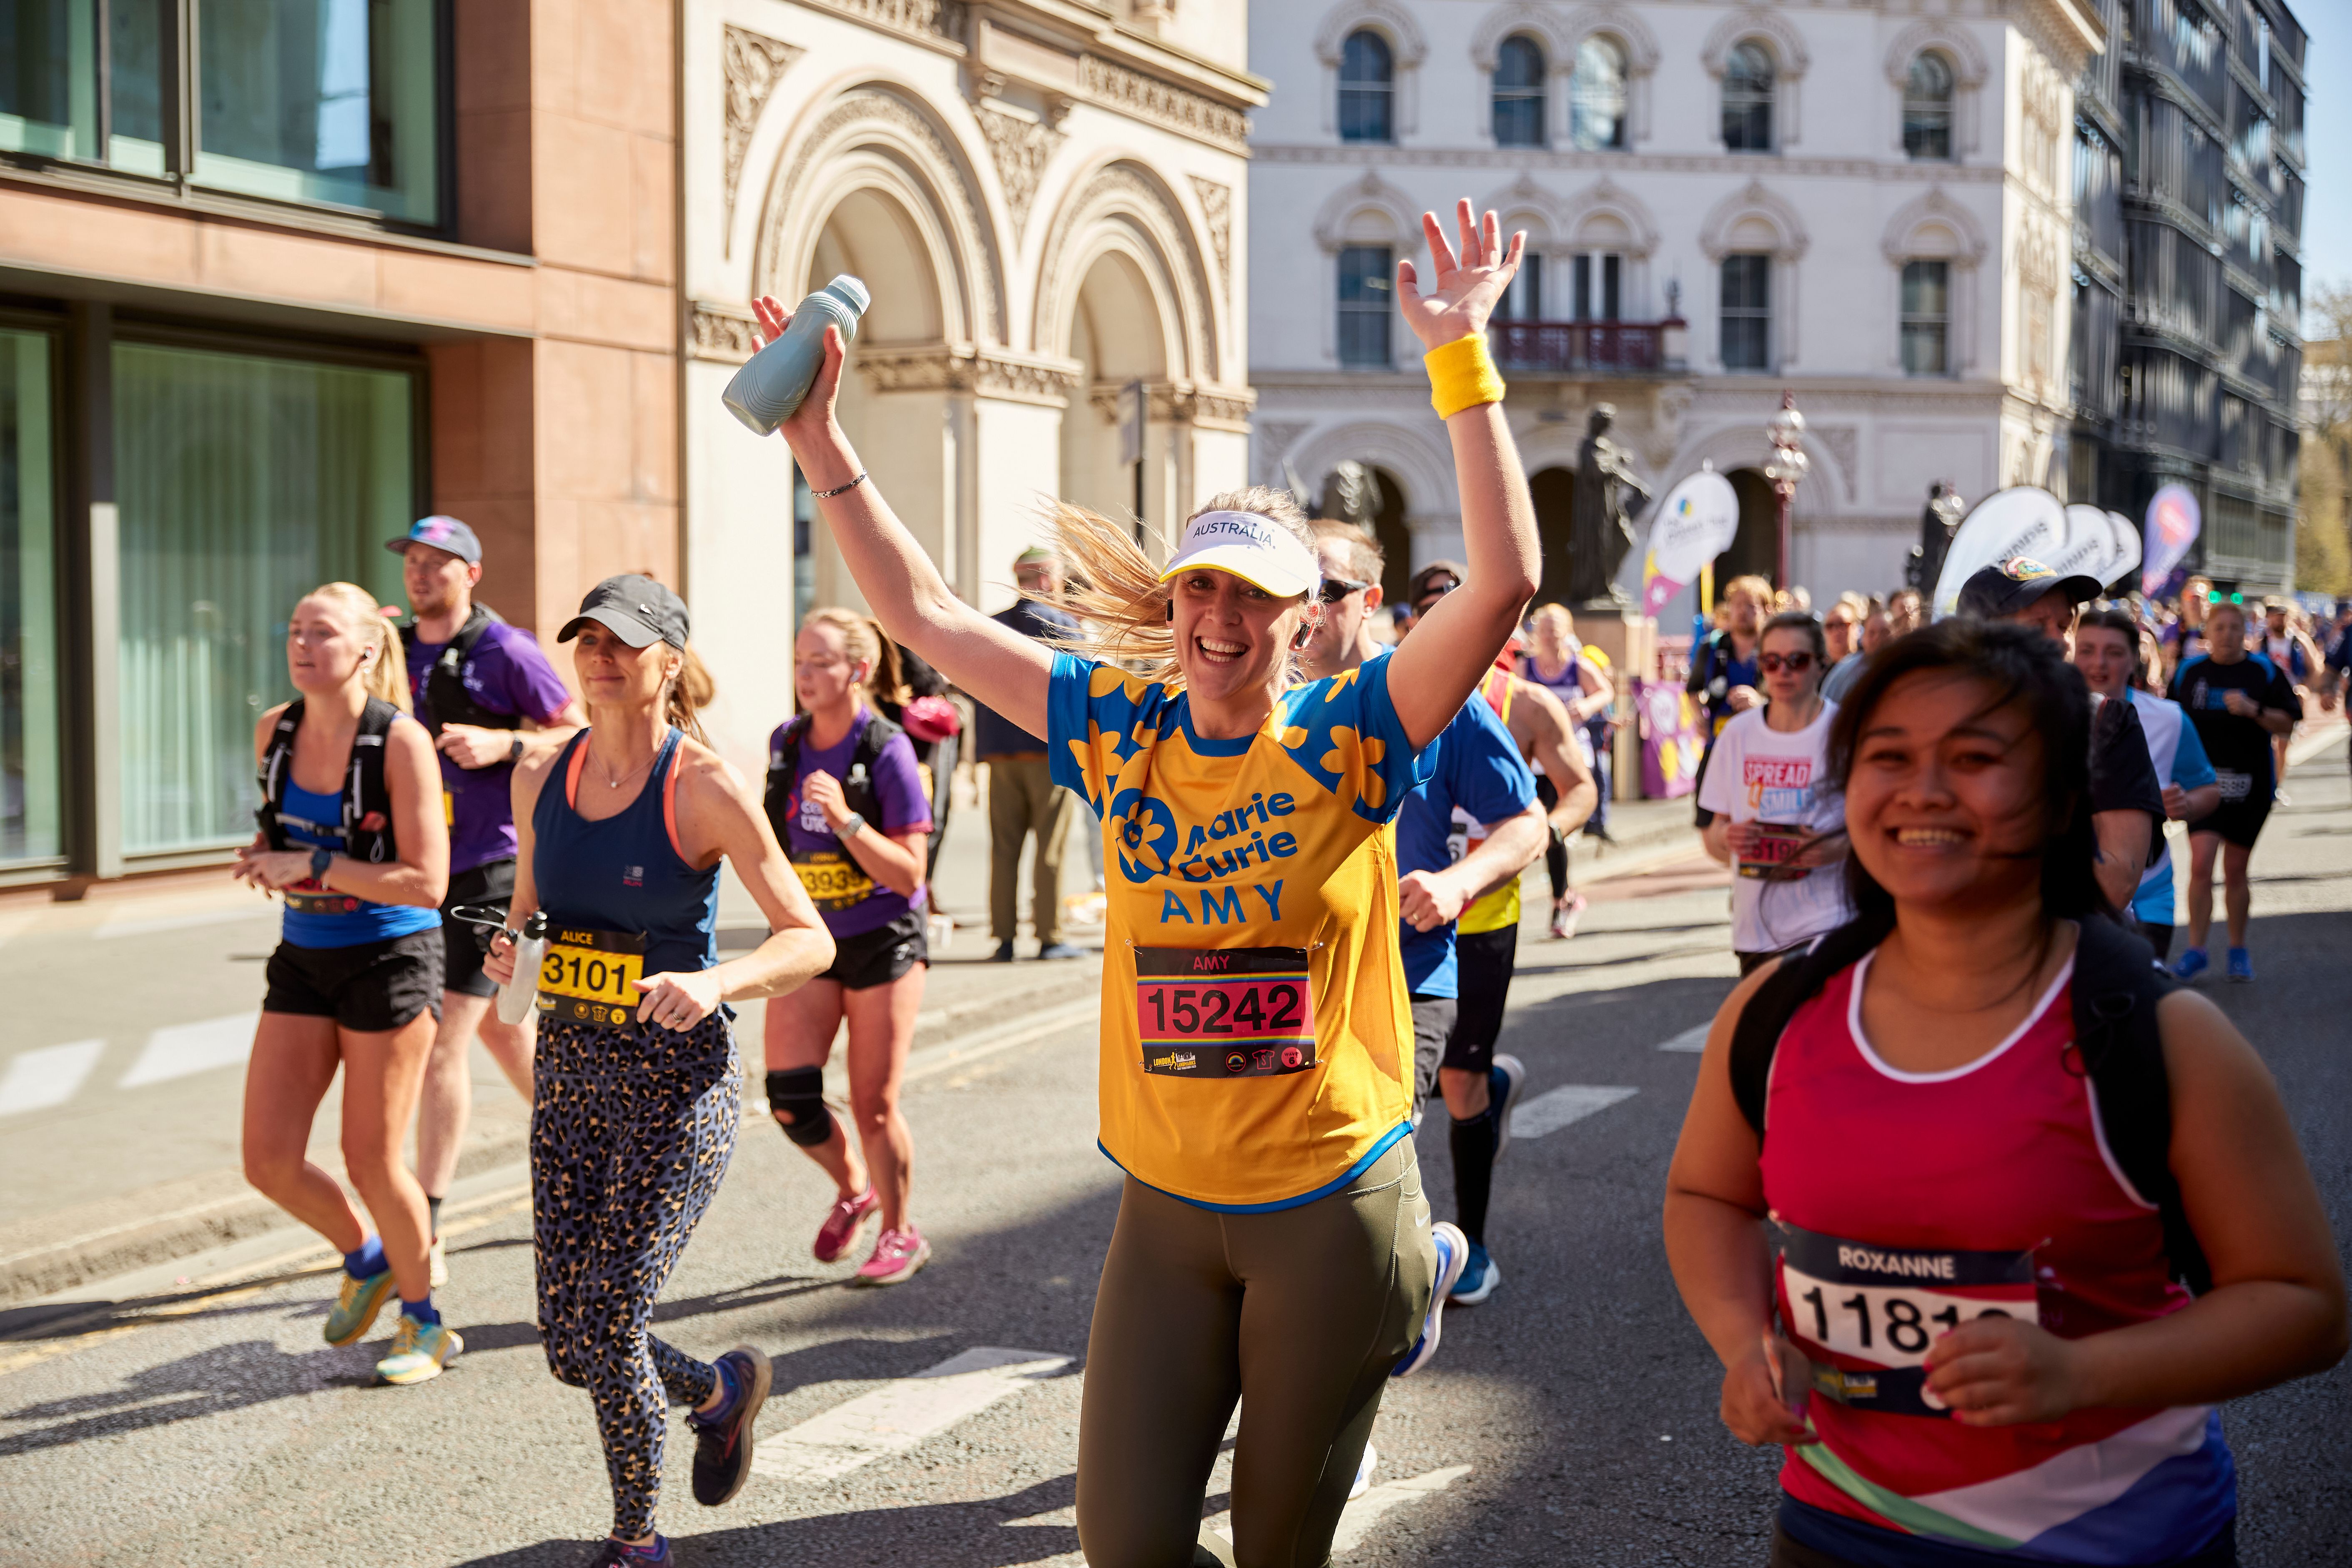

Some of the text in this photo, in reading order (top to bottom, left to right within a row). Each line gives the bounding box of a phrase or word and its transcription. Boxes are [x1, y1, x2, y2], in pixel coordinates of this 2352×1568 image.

[1193, 522, 1271, 546] AUSTRALIA
[1745, 764, 1809, 785] SPREAD
[1178, 831, 1298, 883] Curie
[1160, 879, 1284, 925] AMY
[561, 930, 594, 945] ALICE
[543, 953, 625, 995] 3101
[1193, 956, 1230, 971] AMY
[1148, 984, 1301, 1033] 15242
[1153, 1057, 1171, 1066] LONDON
[1838, 1247, 1955, 1279] ROXANNE
[1803, 1287, 2013, 1354] 1181
